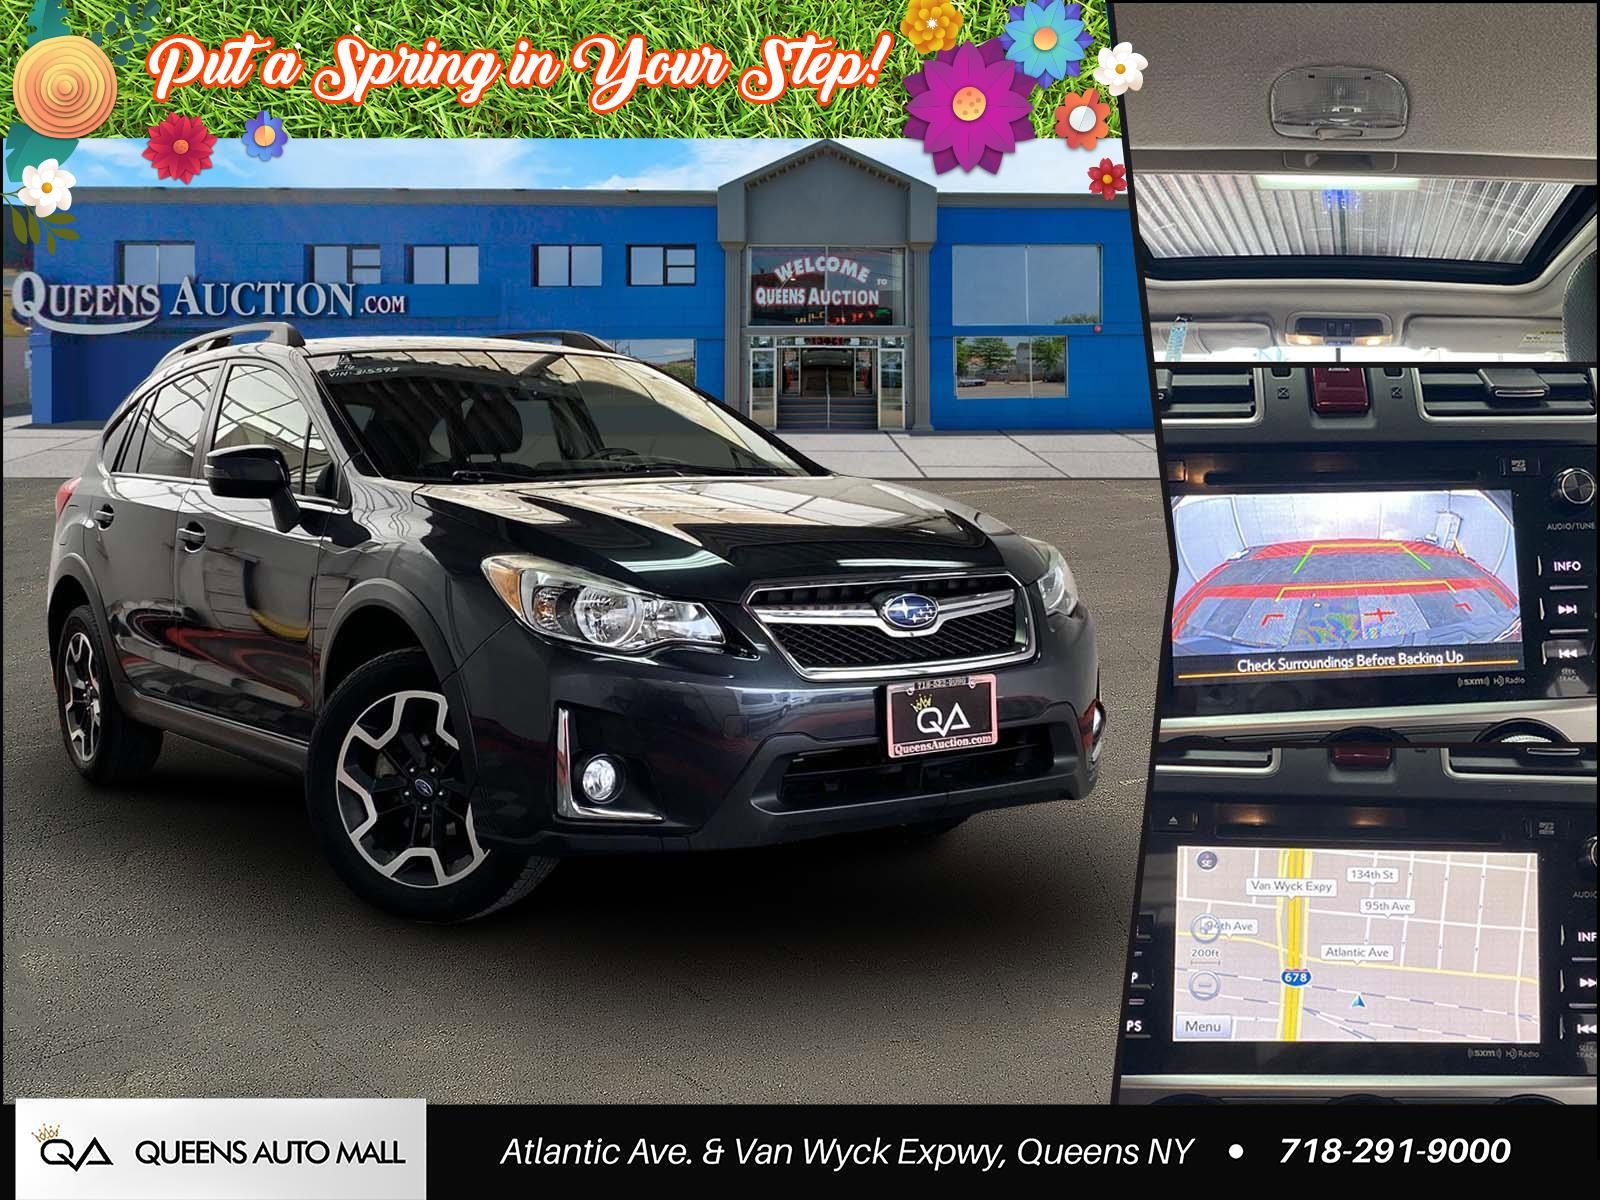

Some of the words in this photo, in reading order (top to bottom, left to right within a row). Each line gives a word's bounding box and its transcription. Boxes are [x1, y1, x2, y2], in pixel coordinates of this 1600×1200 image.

[774, 255, 872, 284] WELCOME
[877, 278, 888, 286] TO
[755, 287, 805, 306] QUEENS
[808, 287, 880, 306] AUCTION
[11, 271, 161, 335] QUEENS
[170, 275, 356, 317] AUCTION
[359, 295, 405, 315] .COM
[1553, 560, 1582, 572] INFO
[1237, 657, 1276, 673] Check
[1278, 655, 1354, 671] Surroundings
[1357, 653, 1396, 667] Before
[1398, 651, 1444, 667] Backing
[1445, 650, 1464, 665] Up
[894, 735, 993, 756] QueensAuction.com
[1351, 869, 1381, 880] 134th
[1383, 870, 1394, 880] St
[1252, 881, 1272, 892] Van
[1274, 881, 1304, 893] Wyck
[1305, 881, 1333, 894] Expy
[1365, 901, 1390, 911] 95th
[1391, 902, 1411, 911] Ave
[1233, 921, 1253, 931] Ave
[1191, 948, 1220, 958] 200ft
[1325, 947, 1365, 957] Atlantic
[1368, 948, 1389, 958] Ave
[1284, 972, 1308, 983] 678
[1185, 1020, 1221, 1033] Menu
